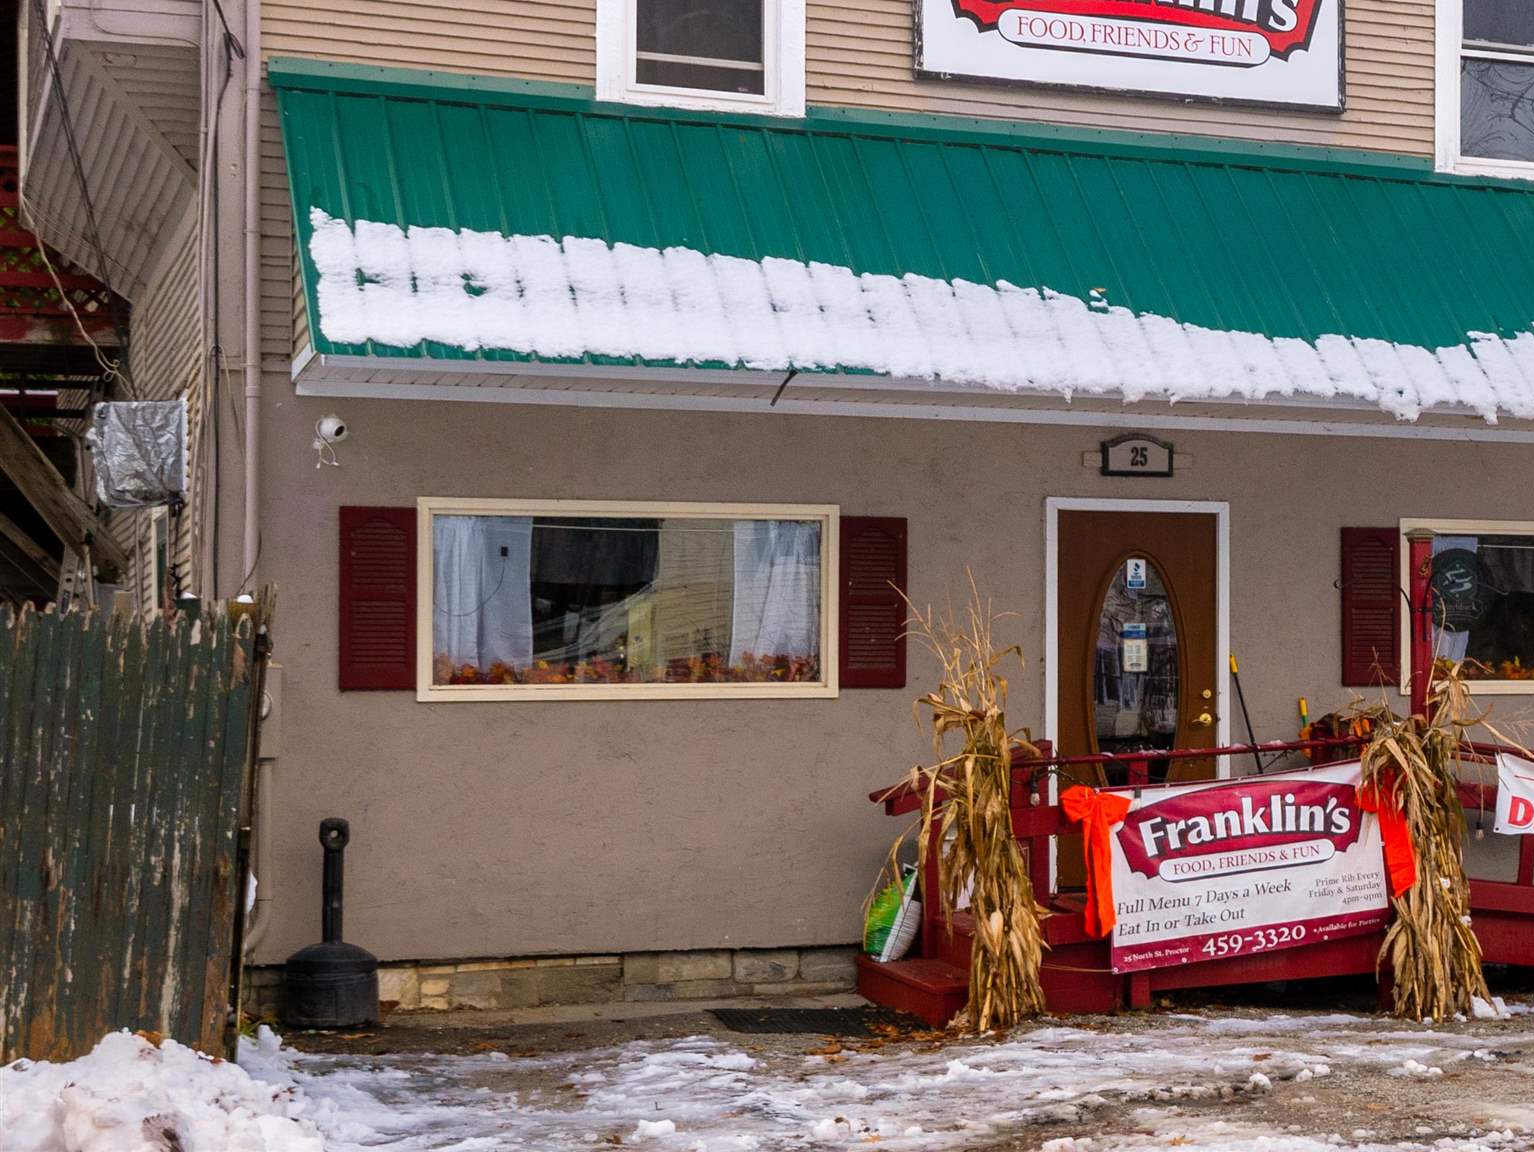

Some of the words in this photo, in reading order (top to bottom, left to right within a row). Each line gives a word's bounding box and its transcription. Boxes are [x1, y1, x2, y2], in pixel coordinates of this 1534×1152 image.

[1017, 15, 1086, 43] FOOD,
[1090, 23, 1181, 50] FRIENDS
[1184, 32, 1206, 52] &
[1210, 34, 1253, 57] FUN
[1130, 447, 1148, 466] 25
[1138, 793, 1351, 858] Franklin's
[1173, 859, 1216, 875] FOOD,
[1219, 851, 1276, 868] FRIENDS
[1279, 849, 1289, 860] &
[1293, 844, 1321, 858] FUN
[1308, 888, 1335, 898] Friday
[1345, 881, 1380, 892] Saturday
[1315, 877, 1339, 887] Prime
[1357, 871, 1380, 881] Every
[1117, 899, 1144, 916] Full
[1149, 896, 1190, 912] Menu
[1195, 895, 1202, 907] 7
[1206, 887, 1239, 904] Days
[1242, 888, 1250, 898] a
[1254, 879, 1292, 895] Week
[1118, 922, 1141, 937] Eat
[1146, 920, 1160, 933] In
[1164, 919, 1180, 929] or
[1184, 911, 1217, 927] Take
[1220, 907, 1245, 923] Out
[1132, 950, 1154, 961] North
[1201, 924, 1307, 957] 459-3320
